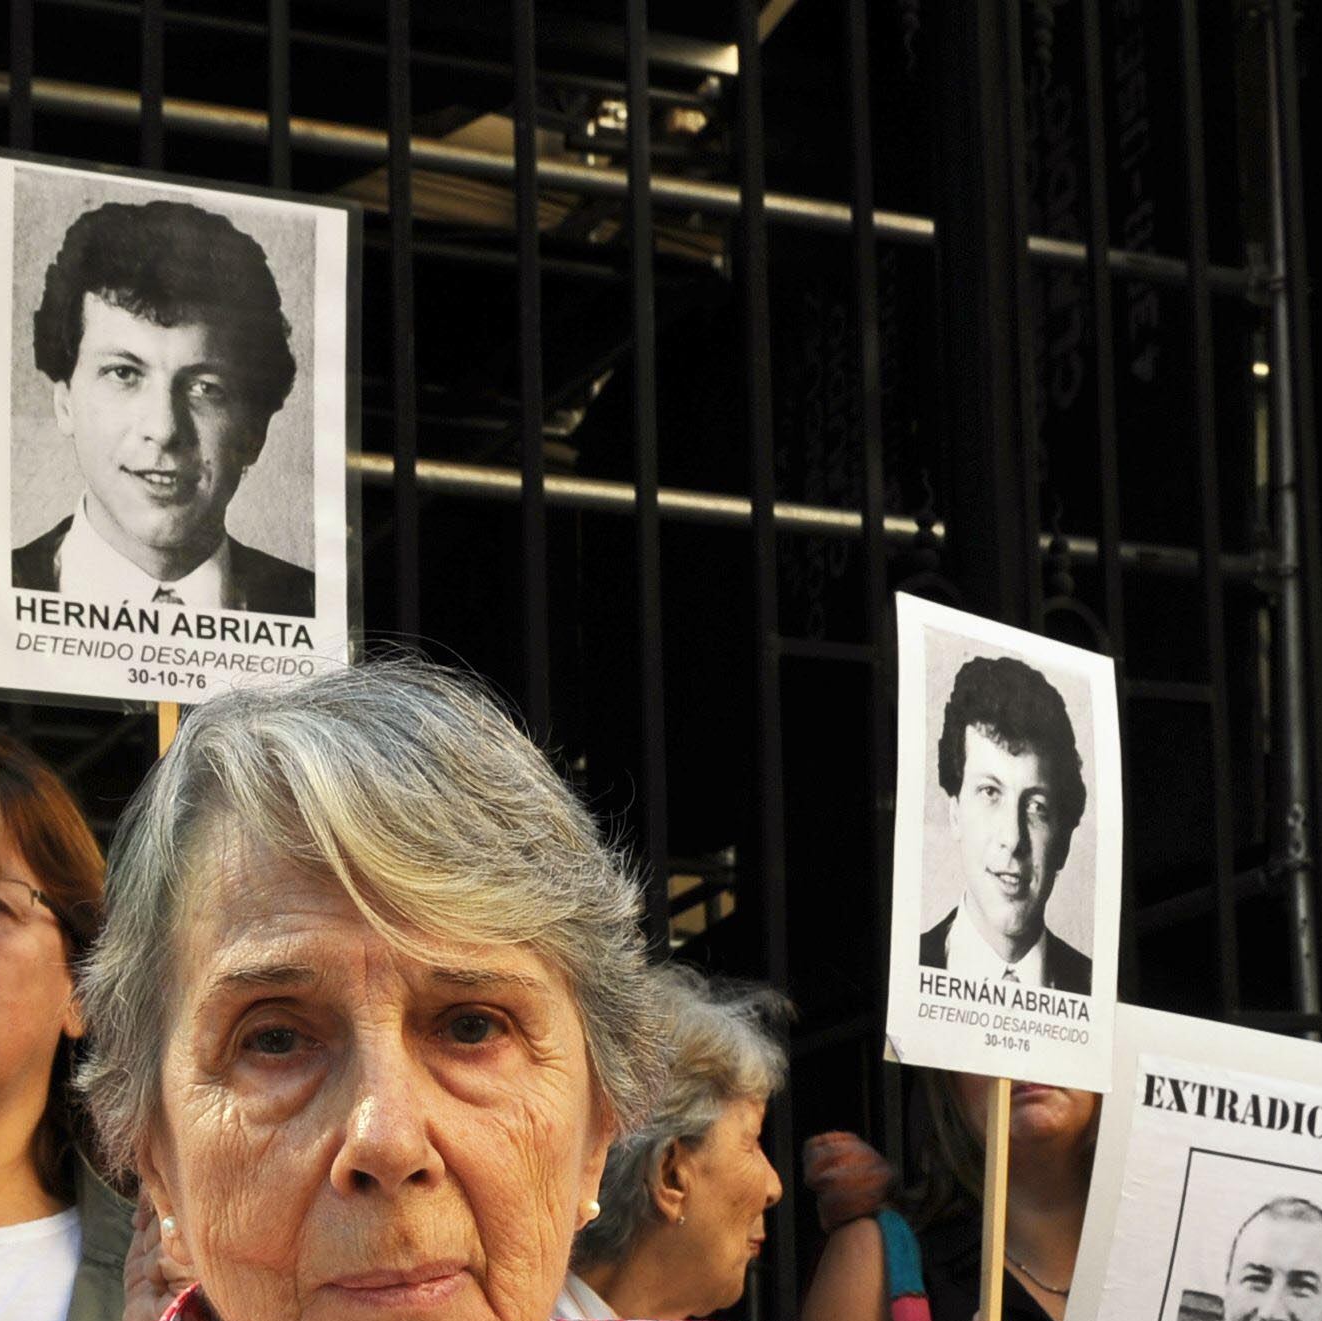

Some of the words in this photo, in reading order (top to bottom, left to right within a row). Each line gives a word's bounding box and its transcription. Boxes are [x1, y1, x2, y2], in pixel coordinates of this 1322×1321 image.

[15, 595, 160, 635] HERNÁN
[171, 610, 314, 650] ABRIATA
[15, 632, 135, 662] DETENIDO
[140, 643, 315, 677] DESAPARECIDO
[127, 667, 207, 689] 30-10-76
[919, 972, 1007, 1006] HERNÁN
[1010, 988, 1091, 1022] ABRIATA
[918, 1003, 990, 1028] DETENIDO
[992, 1014, 1090, 1045] DESAPARECIDO
[984, 1033, 1031, 1052] 30-10-76
